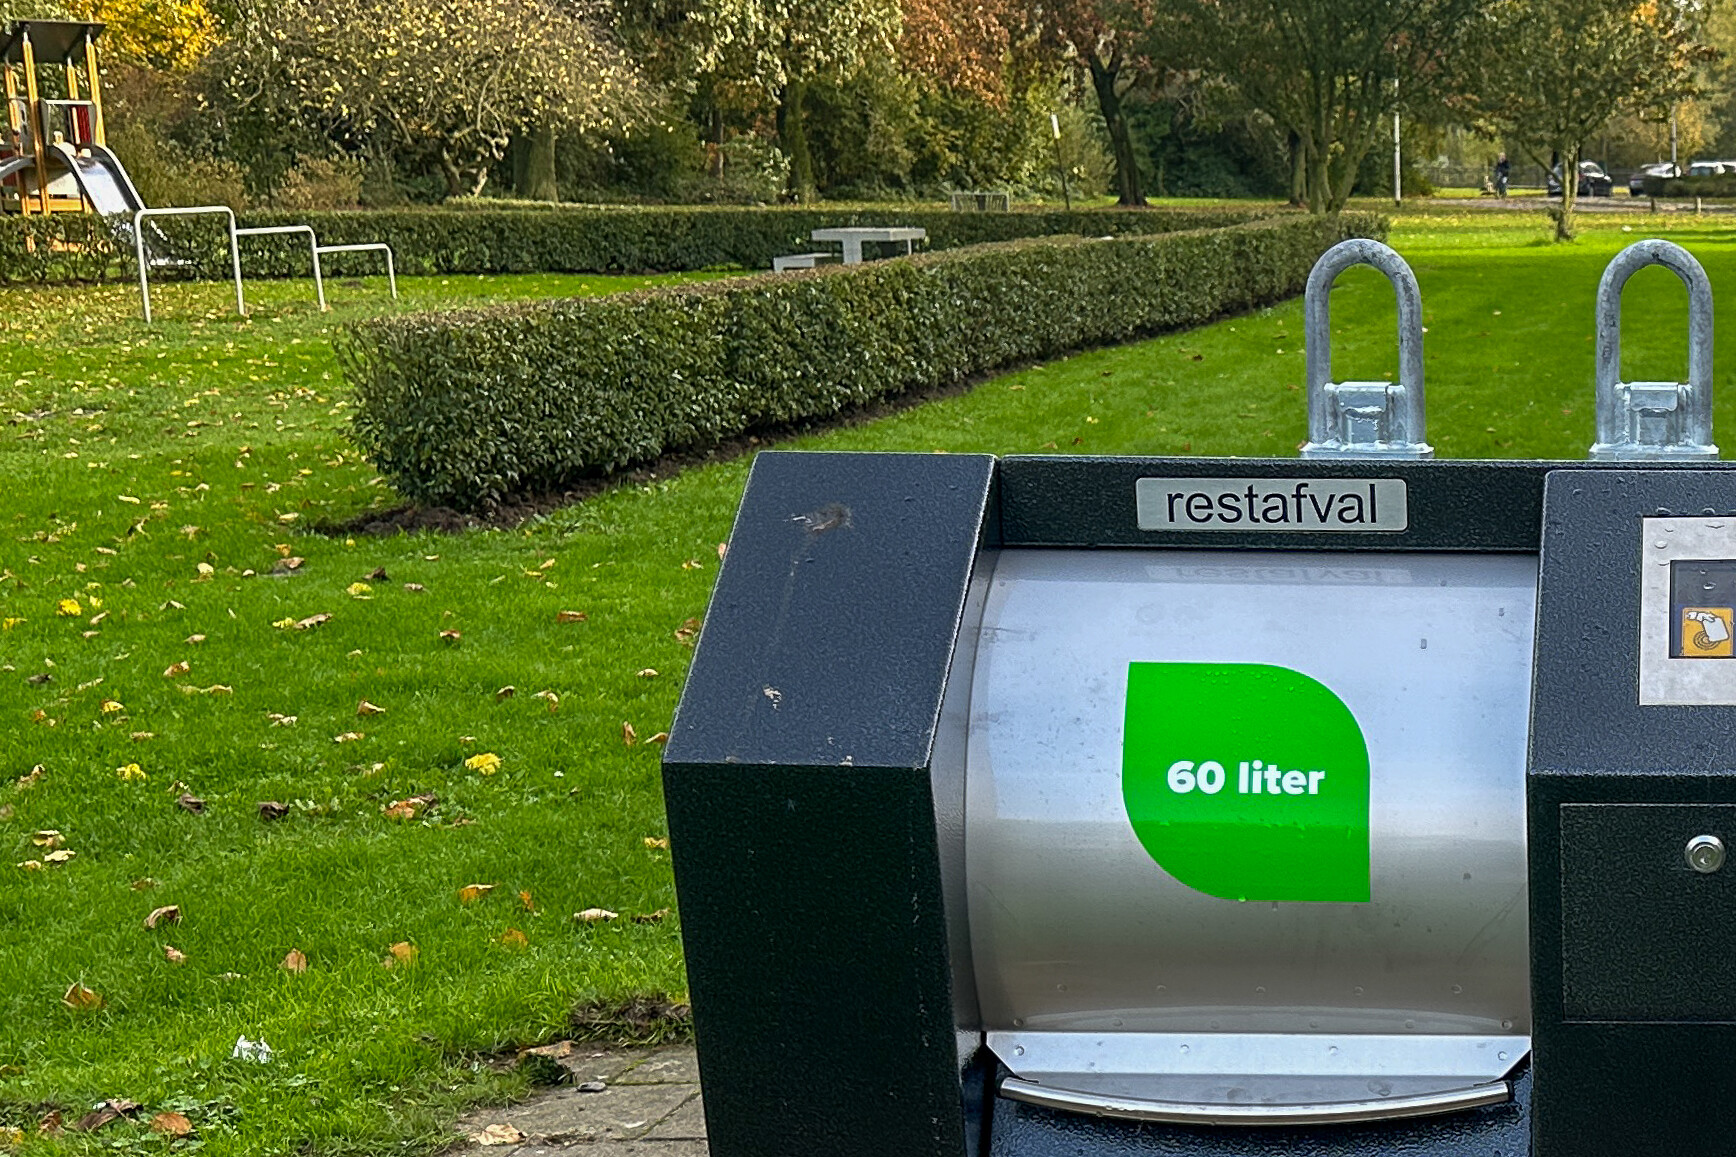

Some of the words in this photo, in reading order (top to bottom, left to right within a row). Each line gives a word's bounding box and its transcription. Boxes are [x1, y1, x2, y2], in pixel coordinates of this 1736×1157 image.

[1168, 484, 1378, 524] restafval
[1168, 761, 1226, 795] 60
[1239, 761, 1326, 795] liter
